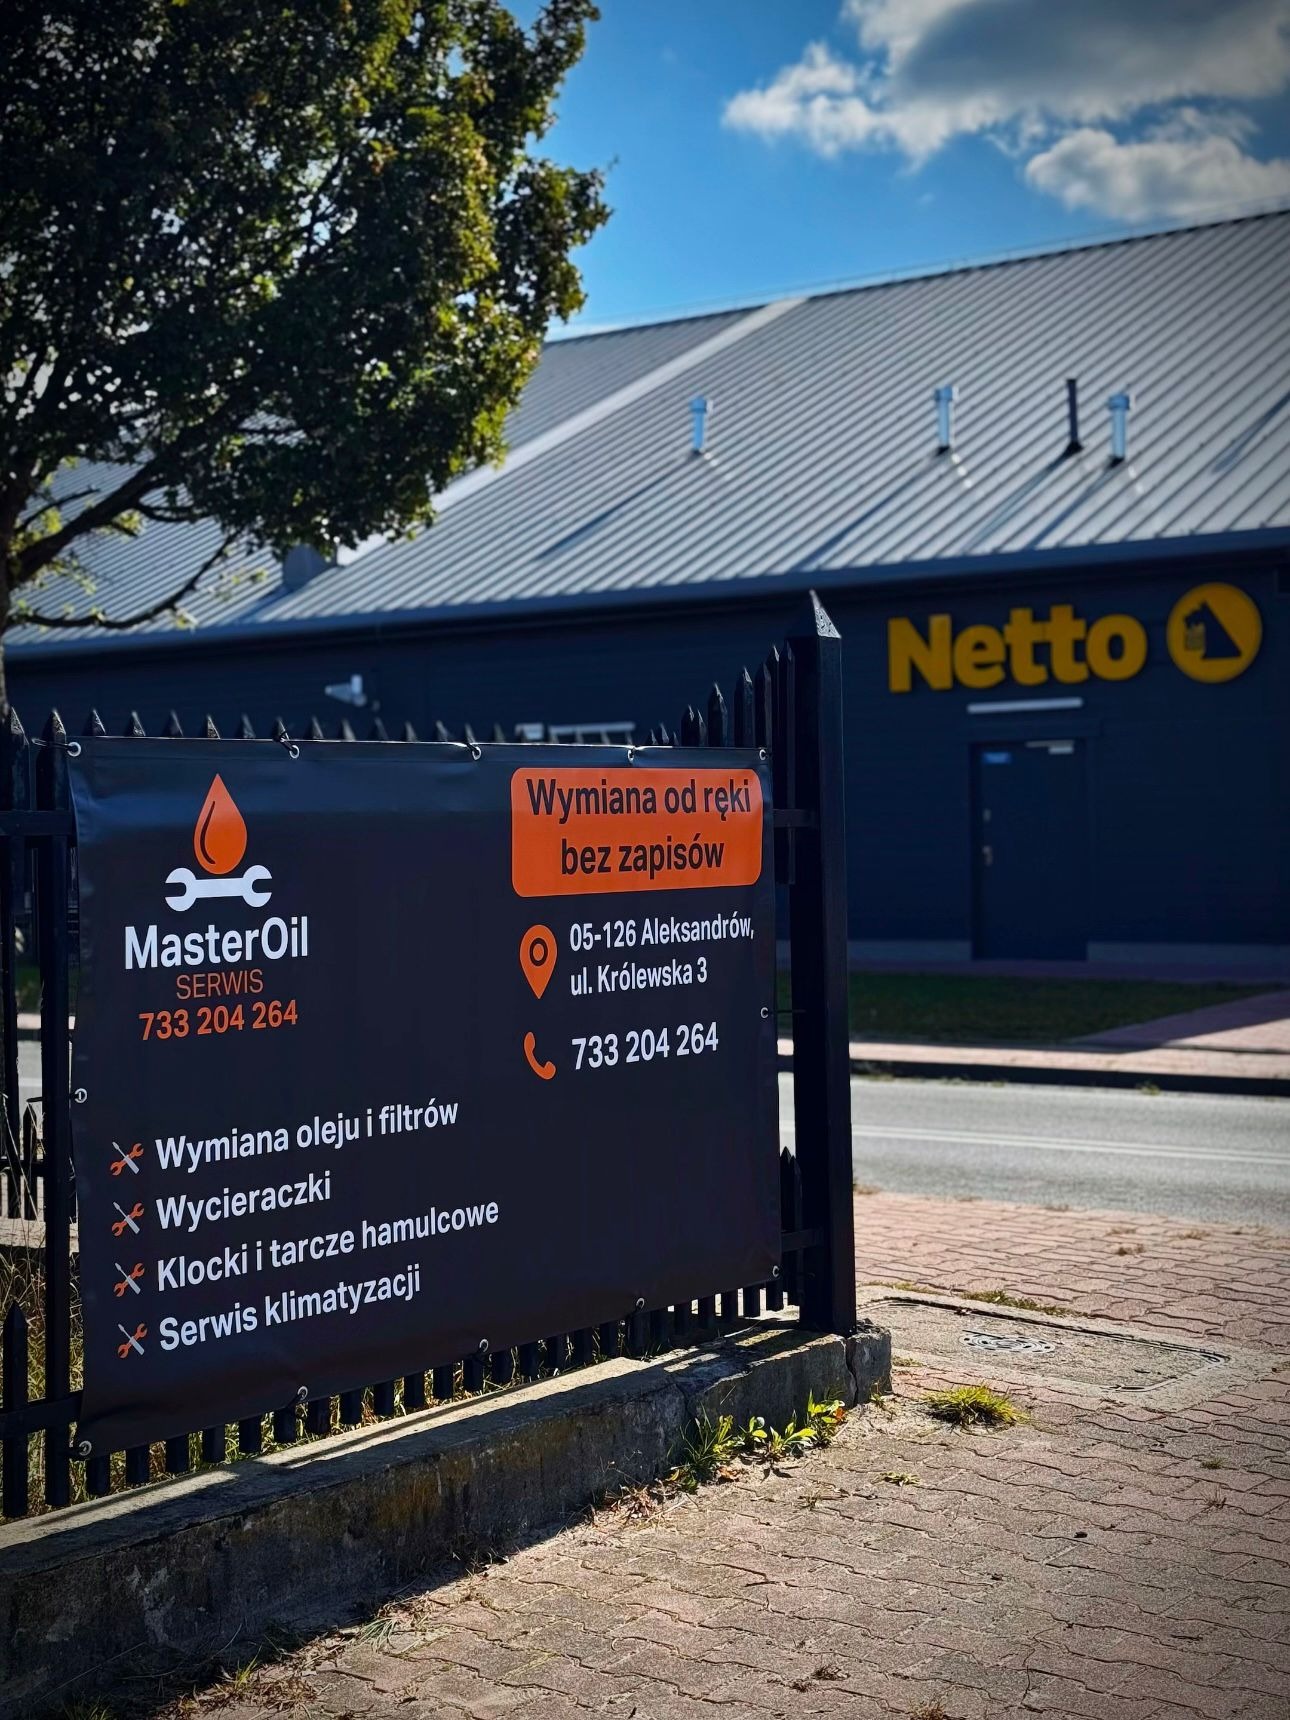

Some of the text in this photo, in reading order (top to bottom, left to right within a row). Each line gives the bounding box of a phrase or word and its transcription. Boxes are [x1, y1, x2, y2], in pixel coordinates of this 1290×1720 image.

[888, 605, 1147, 692] Netto
[526, 779, 750, 824] Wymiana od ręki
[562, 833, 724, 879] bez zapisów
[125, 916, 307, 969] MasterOil
[570, 911, 754, 951] 05-126 Aleksandrów,
[176, 969, 264, 1000] SERWIS
[571, 957, 707, 995] ul. Królewska 3
[139, 1000, 298, 1041] 733 204 264
[572, 1022, 718, 1069] 733 204 264
[155, 1098, 458, 1173] Wymiana oleju i filtrów
[156, 1170, 330, 1232] Wycieraczki
[158, 1202, 498, 1291] Klocki i tarcze hamulcowe
[160, 1264, 419, 1350] Serwis klimatyzacji
